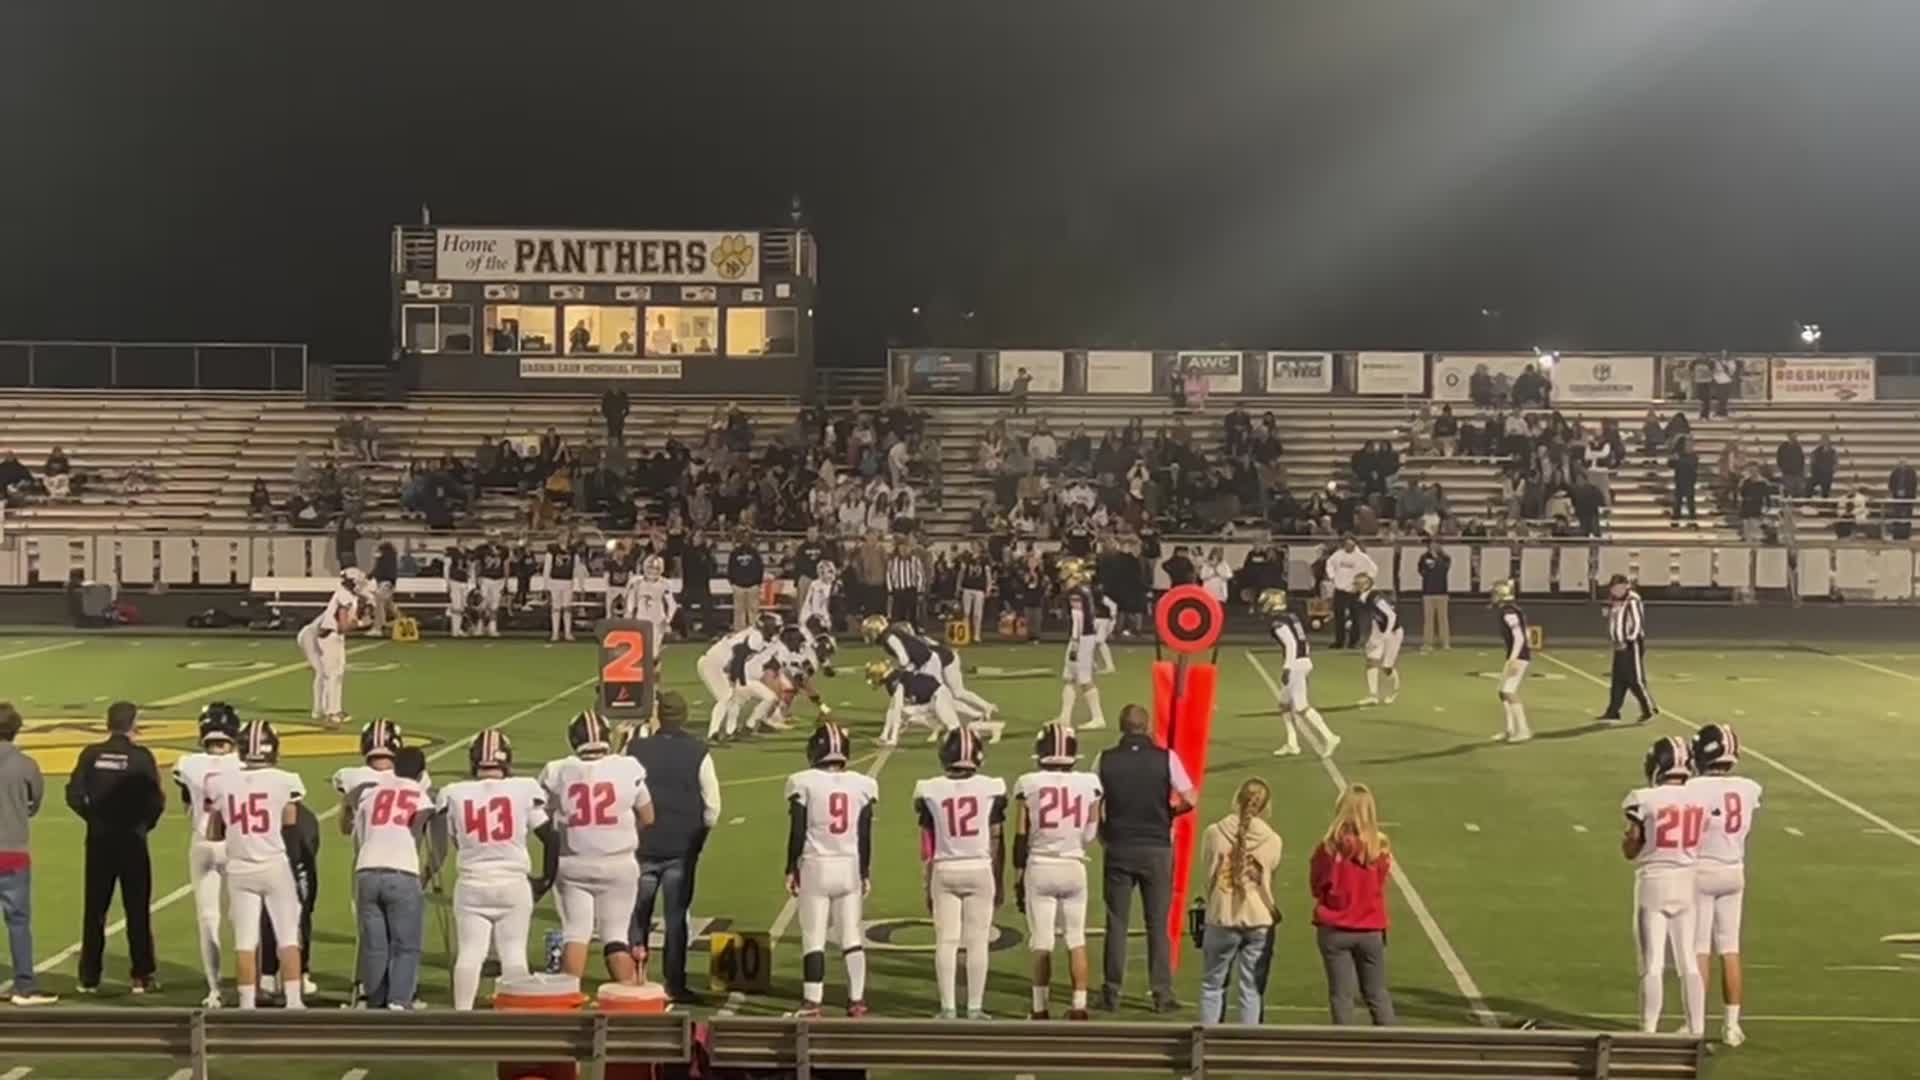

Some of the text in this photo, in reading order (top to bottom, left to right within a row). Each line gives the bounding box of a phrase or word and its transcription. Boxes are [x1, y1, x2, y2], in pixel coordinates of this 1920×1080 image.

[442, 233, 497, 253] Home
[465, 254, 509, 272] of the
[514, 239, 708, 274] PANTHERS
[1187, 356, 1231, 369] AWC
[602, 629, 645, 683] 2
[227, 792, 271, 835] 45
[370, 788, 420, 828] 85
[463, 796, 513, 844] 43
[567, 781, 619, 828] 32
[828, 791, 849, 835] 9
[941, 796, 980, 838] 12
[1038, 785, 1084, 830] 24
[1655, 803, 1704, 849] 20
[1723, 791, 1744, 835] 8
[717, 935, 762, 982] 40
